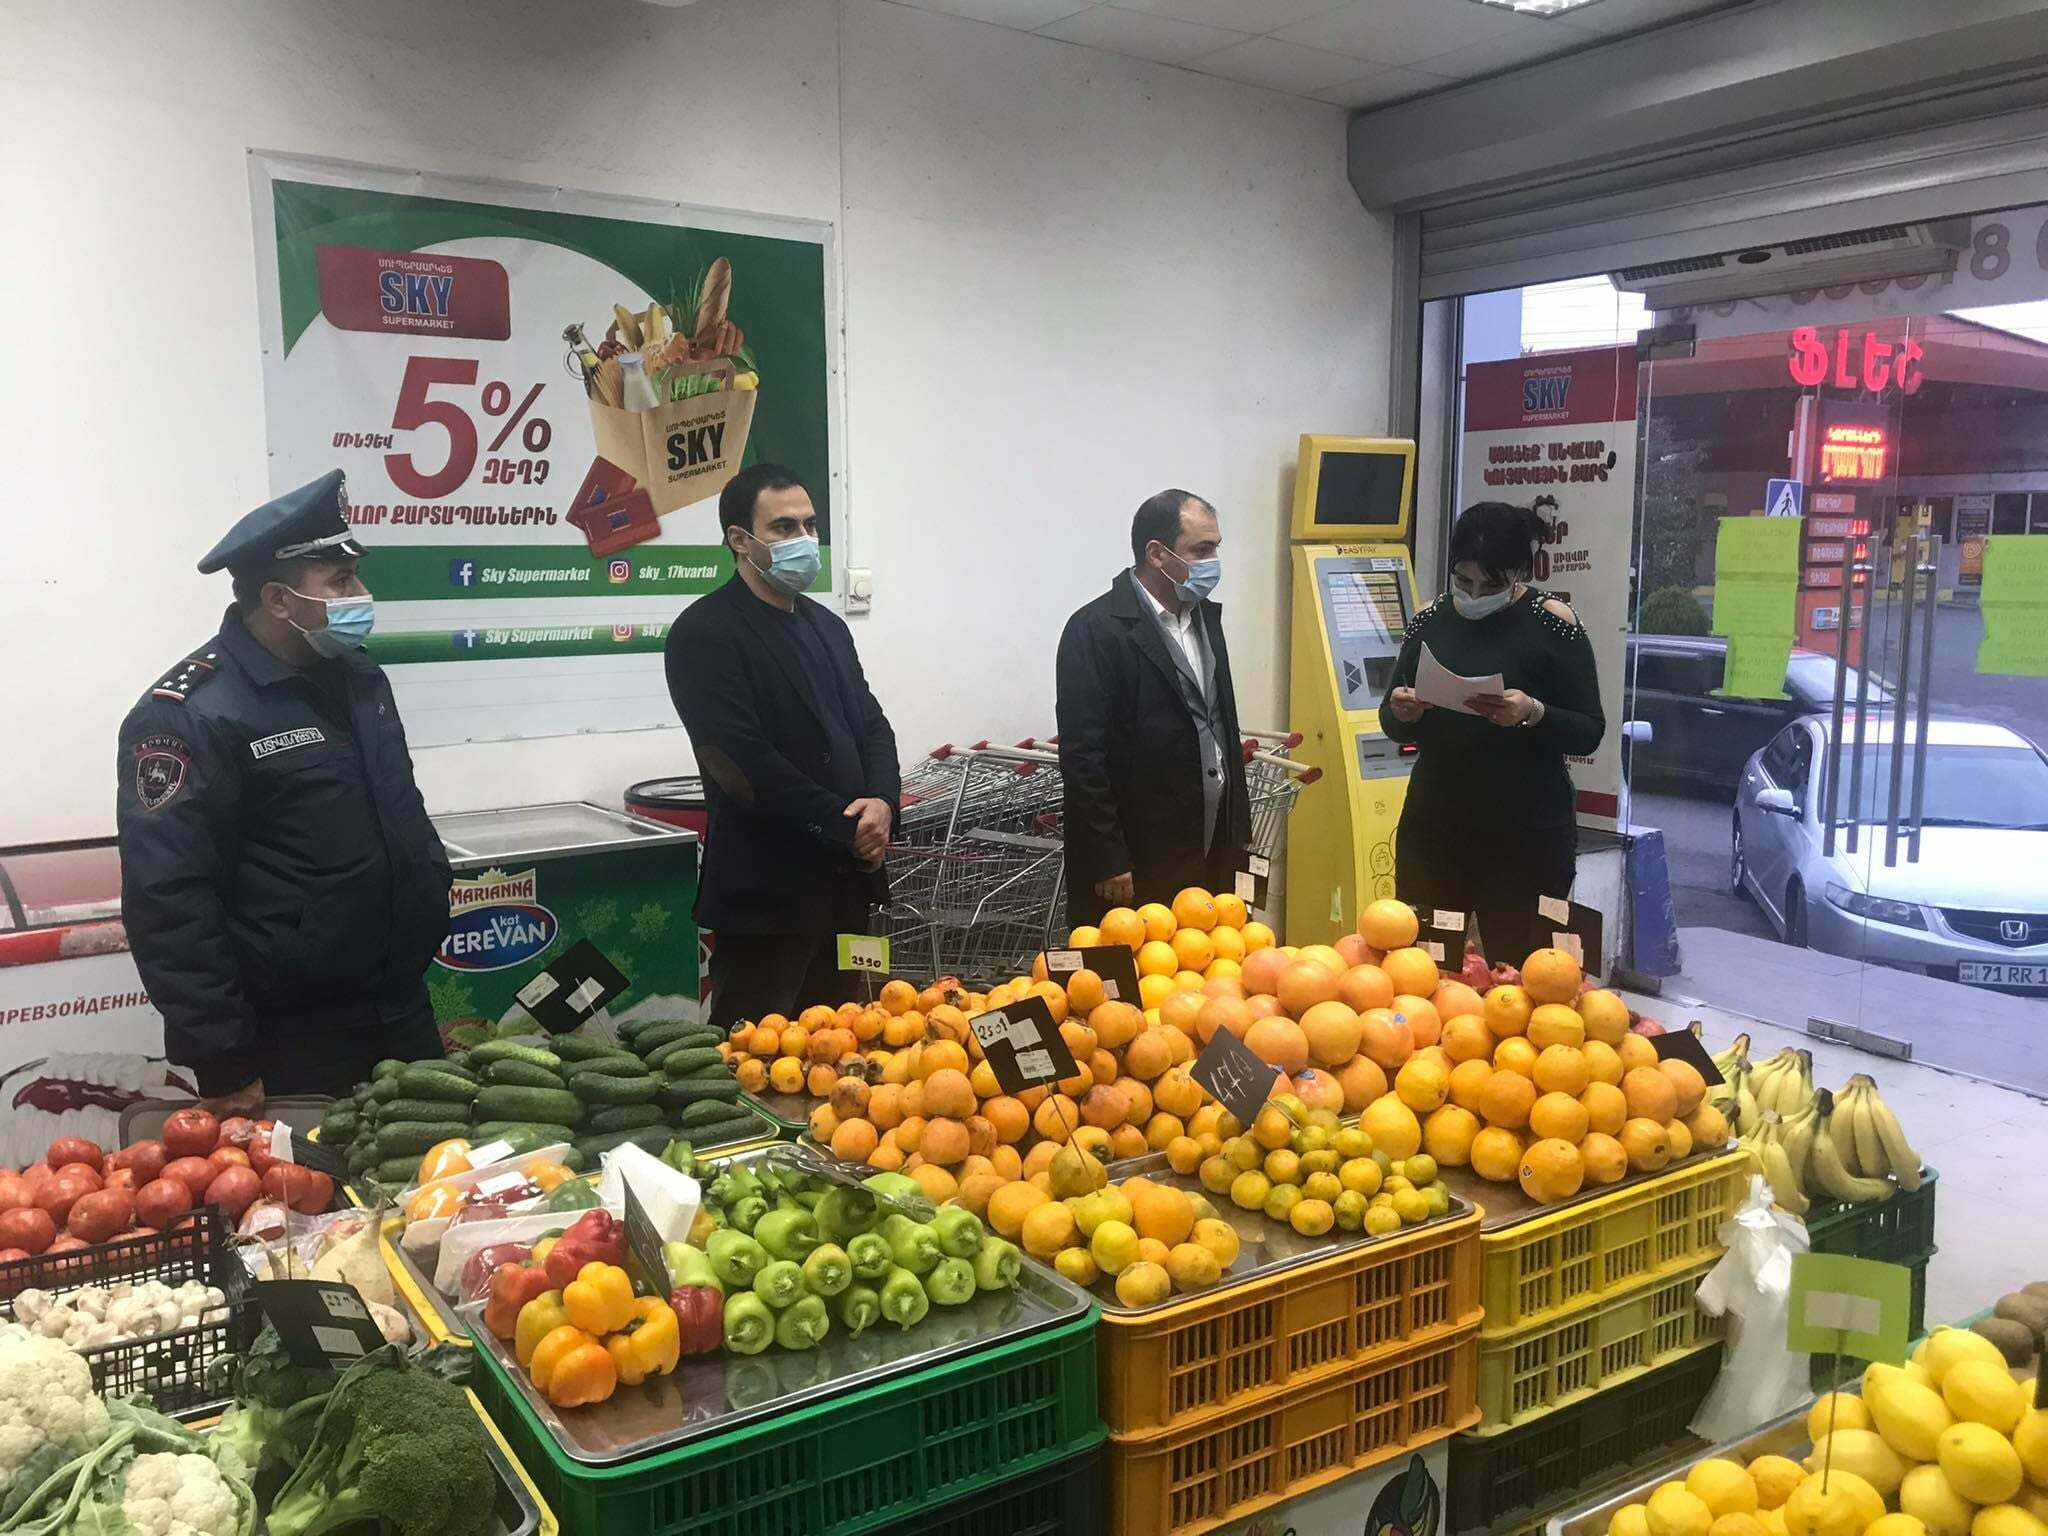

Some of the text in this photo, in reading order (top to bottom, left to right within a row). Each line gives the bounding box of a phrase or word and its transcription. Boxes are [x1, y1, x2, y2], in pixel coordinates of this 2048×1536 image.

[378, 270, 454, 317] SKY
[382, 315, 455, 330] SUPERMARKET
[1522, 375, 1572, 412] SKY
[1521, 411, 1570, 422] SUPERMARKET
[384, 356, 552, 499] 5%
[666, 421, 726, 471] SKY
[667, 460, 727, 483] SUPERMARKET
[481, 566, 591, 584] Sky Supermarket
[638, 565, 718, 581] sky_17kvartal
[485, 626, 594, 645] Sky Supermarket
[450, 879, 533, 906] MARIANNA
[500, 914, 520, 927] kat
[440, 918, 546, 957] YEREVAN
[1982, 965, 2002, 982] 71
[2008, 966, 2033, 984] RR
